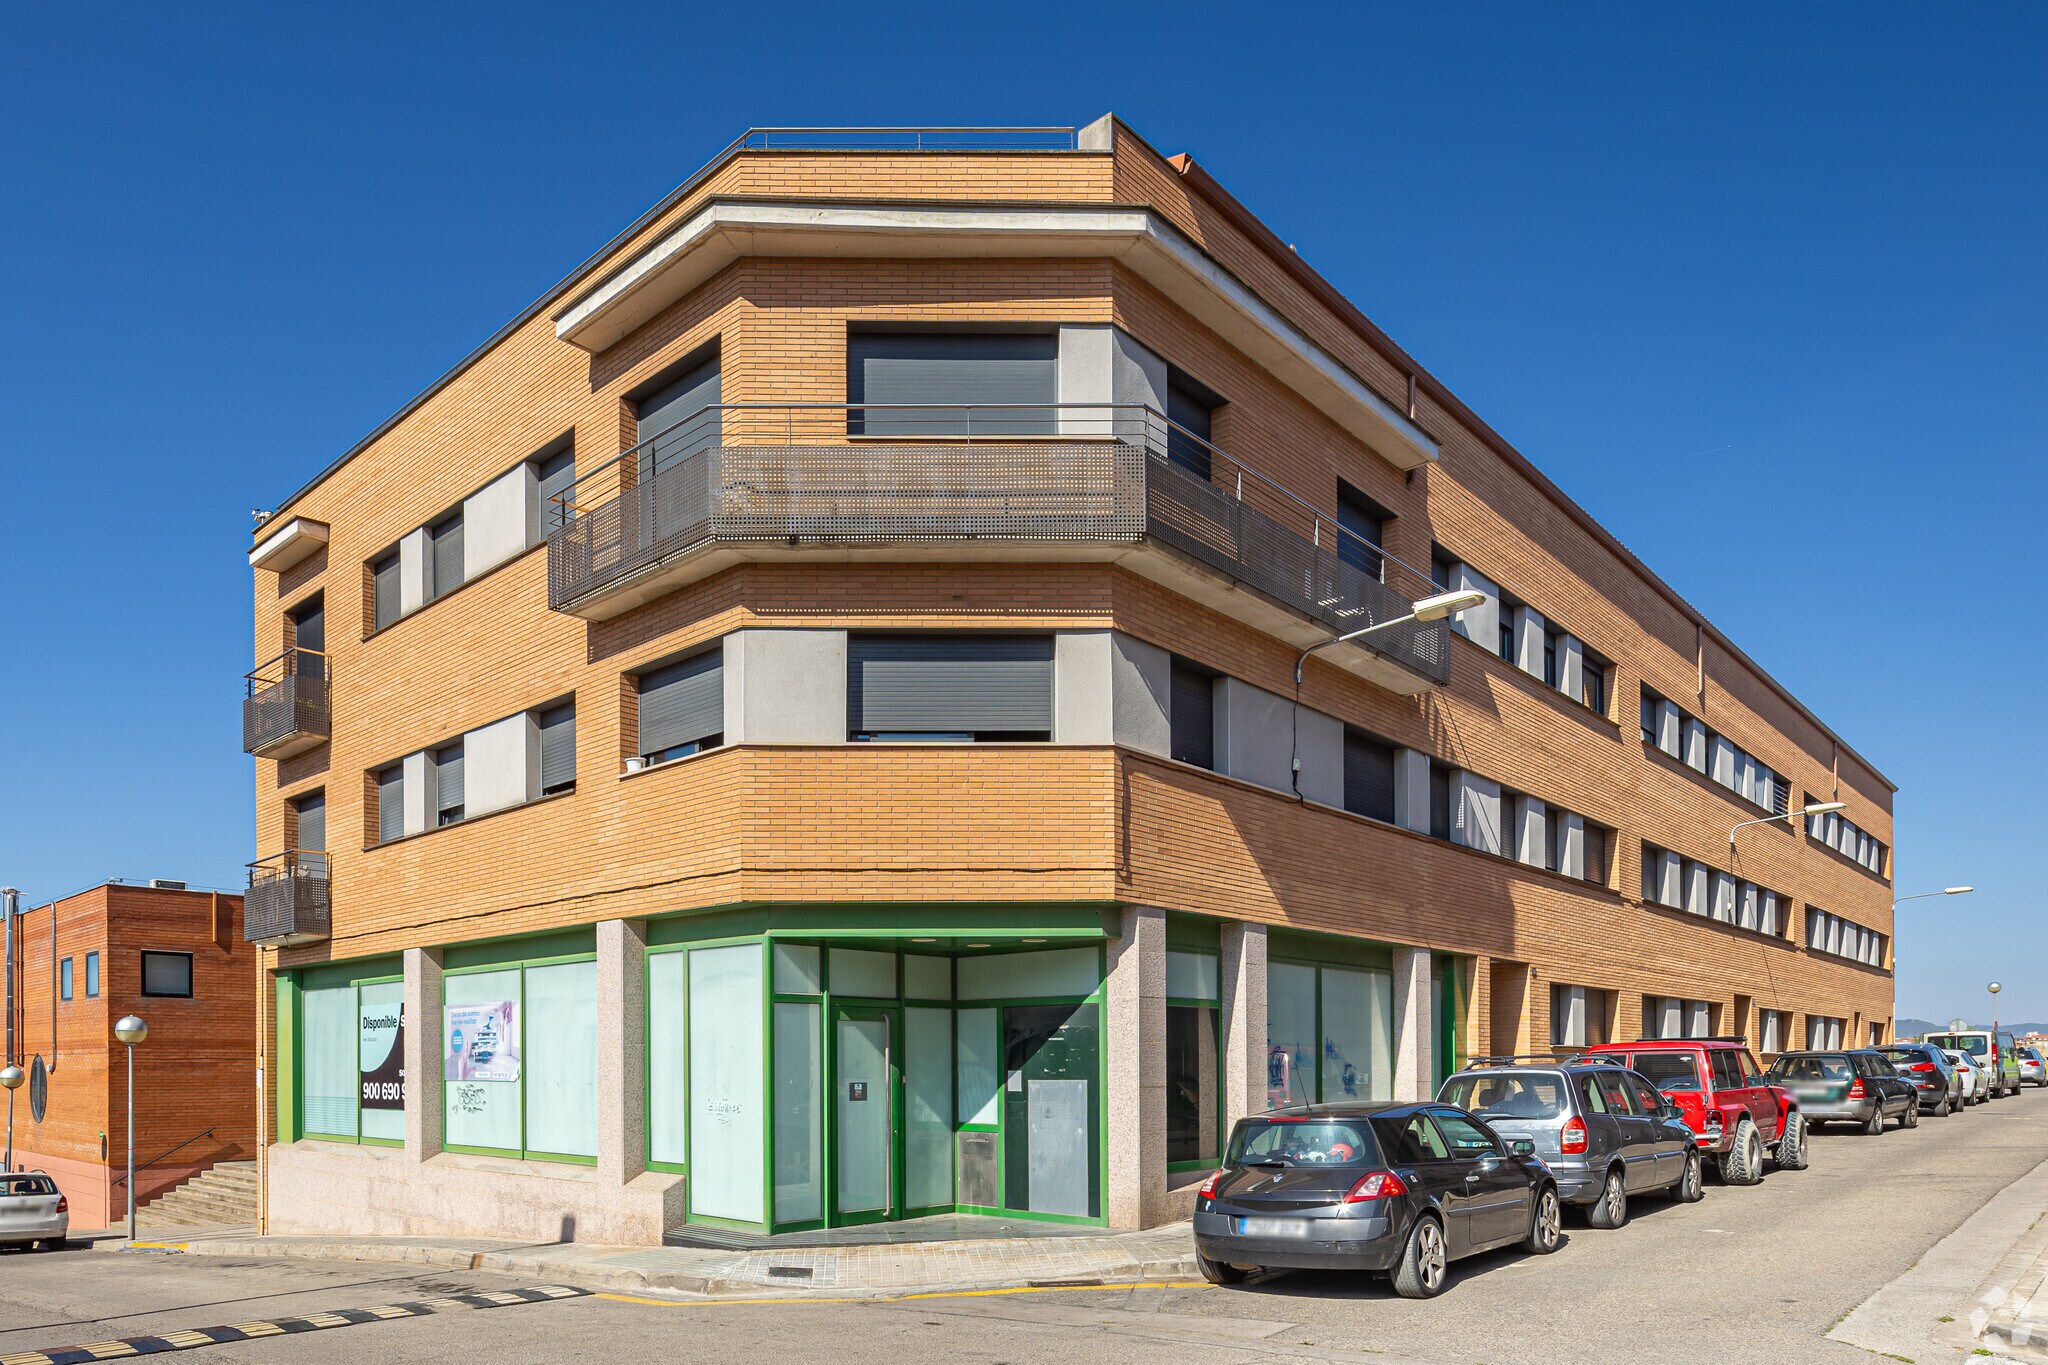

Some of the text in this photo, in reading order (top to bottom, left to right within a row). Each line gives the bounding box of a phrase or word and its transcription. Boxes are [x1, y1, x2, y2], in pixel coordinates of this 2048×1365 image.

[363, 1015, 397, 1031] Disponible
[363, 1082, 380, 1099] 900
[381, 1082, 400, 1100] 690
